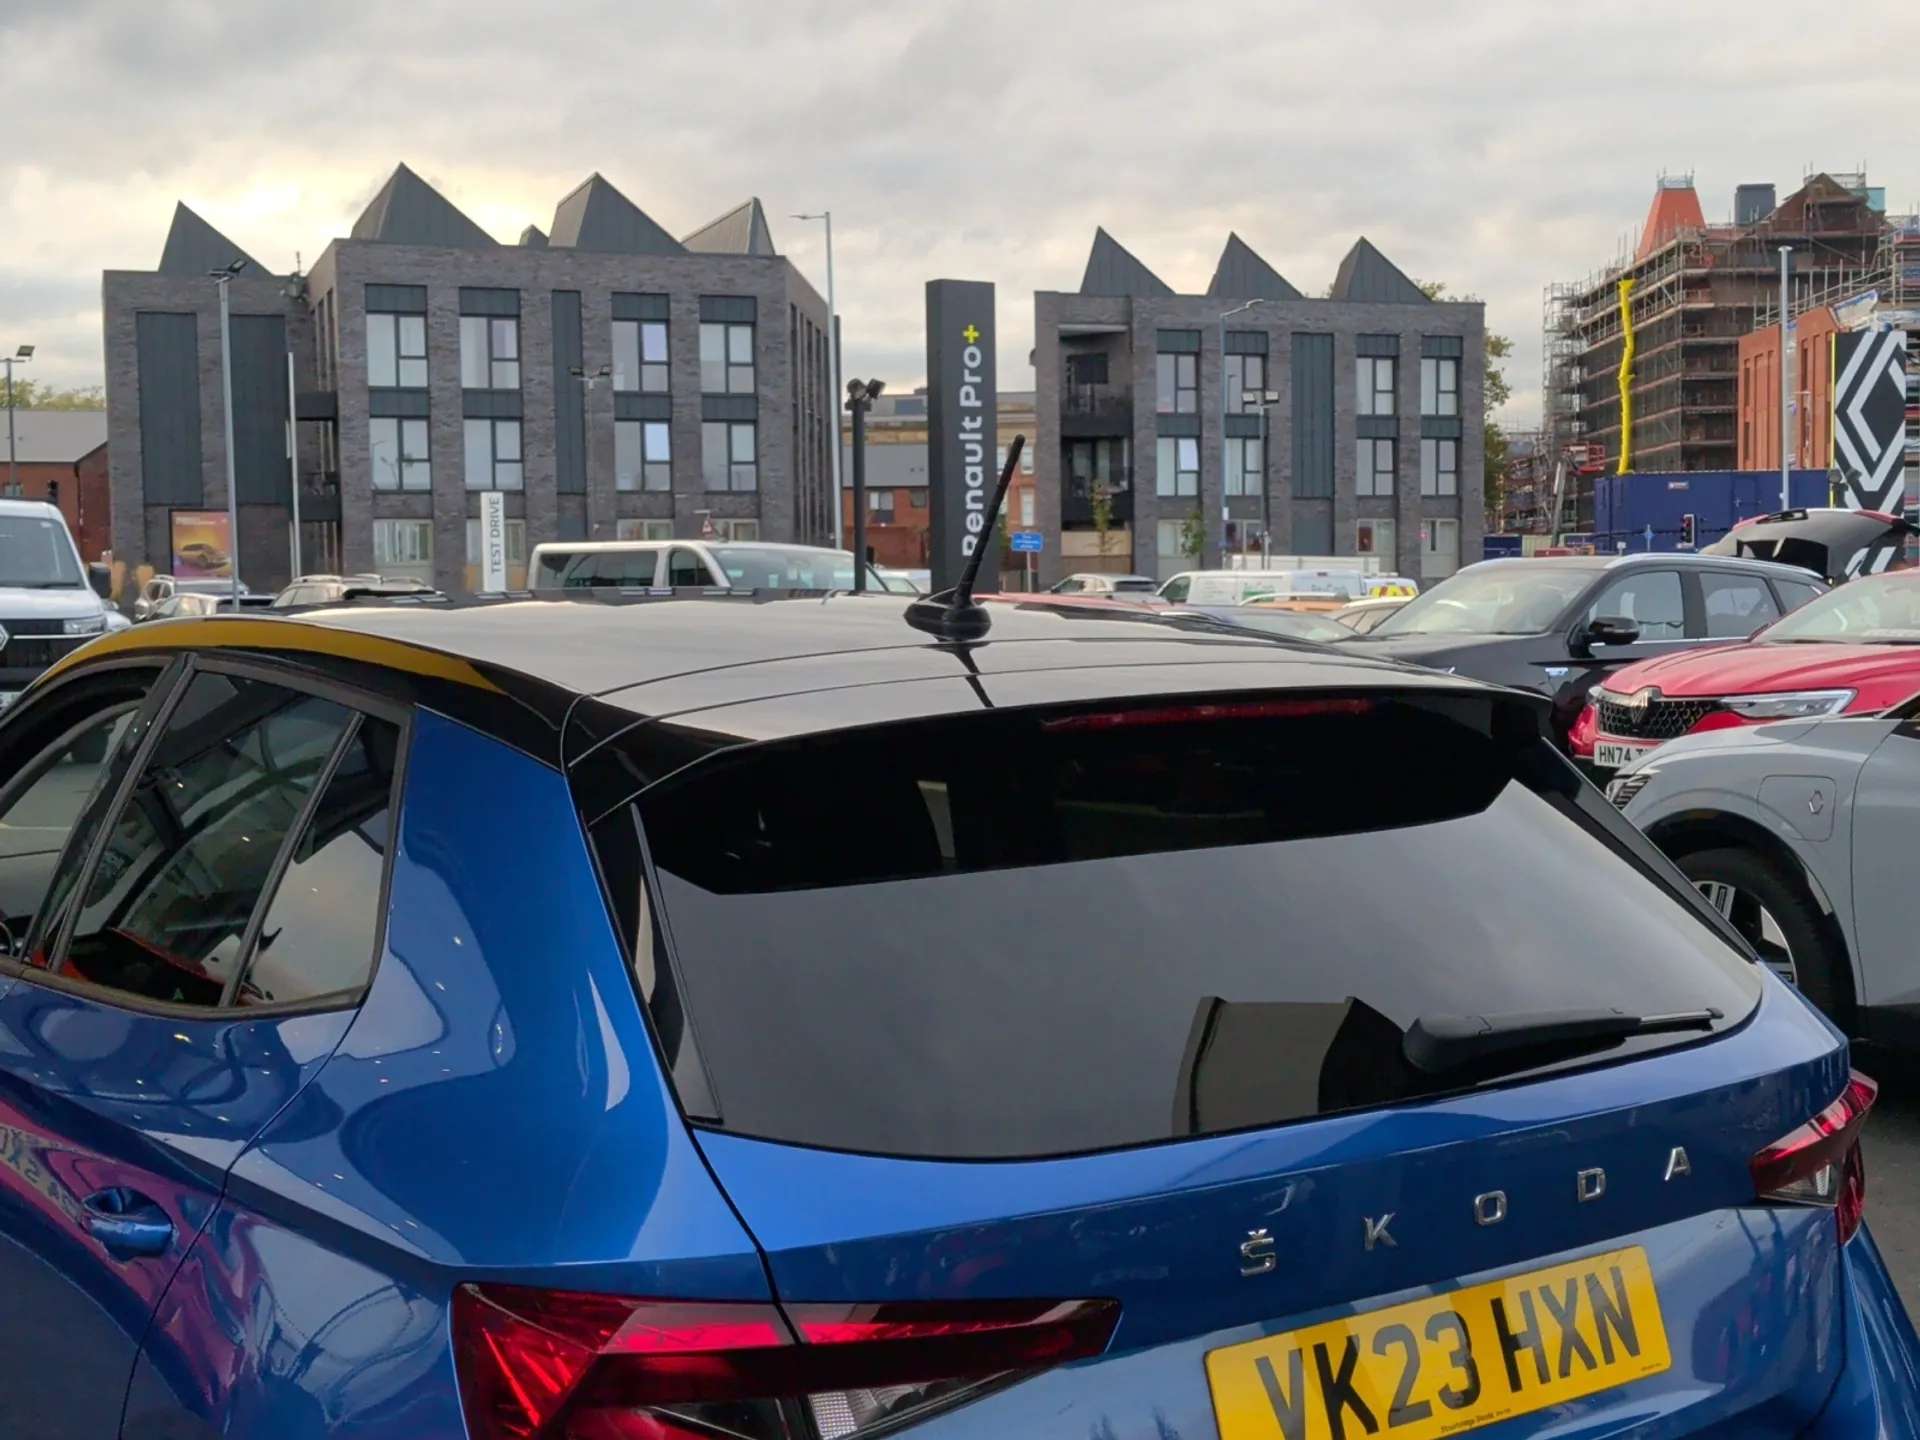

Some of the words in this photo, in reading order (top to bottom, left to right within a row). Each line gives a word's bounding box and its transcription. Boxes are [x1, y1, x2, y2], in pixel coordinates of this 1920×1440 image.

[489, 497, 501, 539] DRIVE
[958, 415, 984, 557] Renault
[490, 542, 502, 574] TEST
[1598, 744, 1632, 765] HN74
[1240, 1146, 1693, 1277] ŠKODA
[1254, 1310, 1481, 1440] VK23
[1490, 1265, 1641, 1393] HXN
